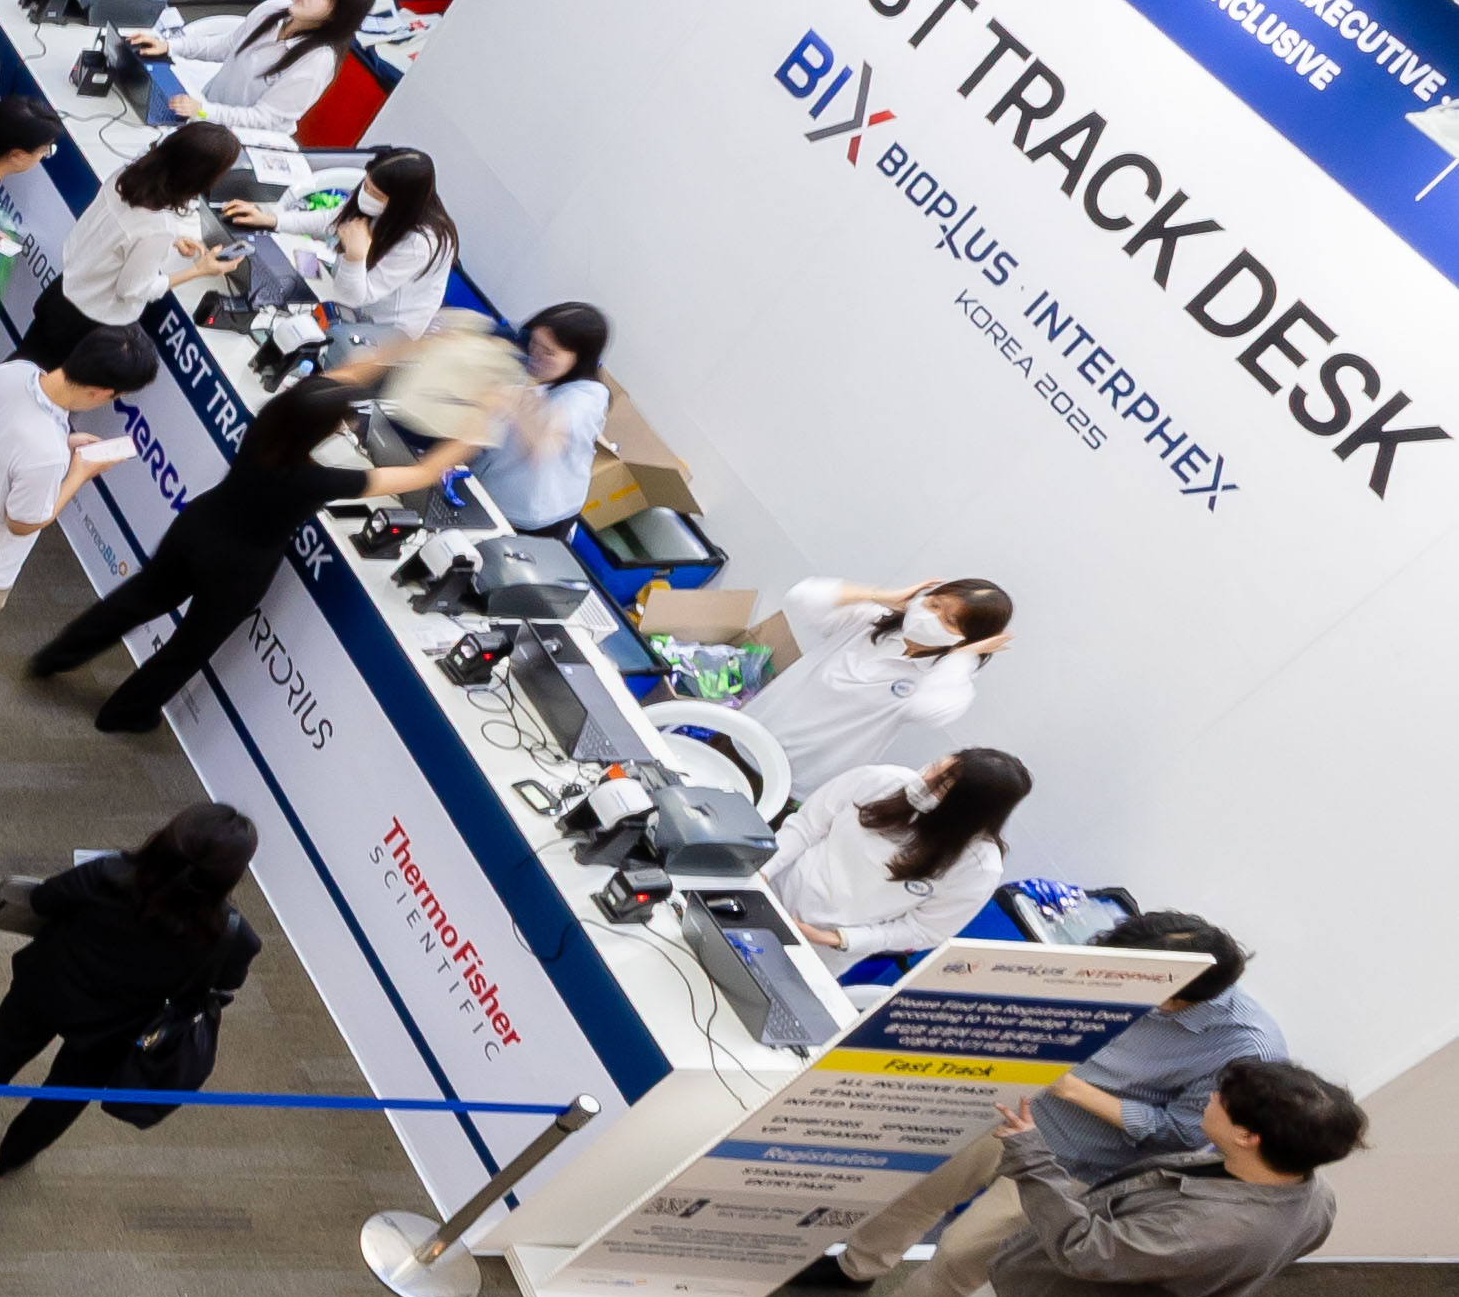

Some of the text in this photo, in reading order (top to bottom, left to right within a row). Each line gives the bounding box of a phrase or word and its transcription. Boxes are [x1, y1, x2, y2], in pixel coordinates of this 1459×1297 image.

[773, 28, 896, 167] BIX
[876, 142, 1240, 513] BIOPLUS INTERPHEX
[957, 18, 1226, 291] TRACK
[1184, 248, 1454, 501] DESK
[158, 309, 212, 389] FAST
[954, 289, 1107, 452] KOREA 2025
[367, 844, 501, 1062] SCIENTIFIC
[884, 1059, 994, 1077] Fast Track
[764, 1146, 889, 1167] Registration
